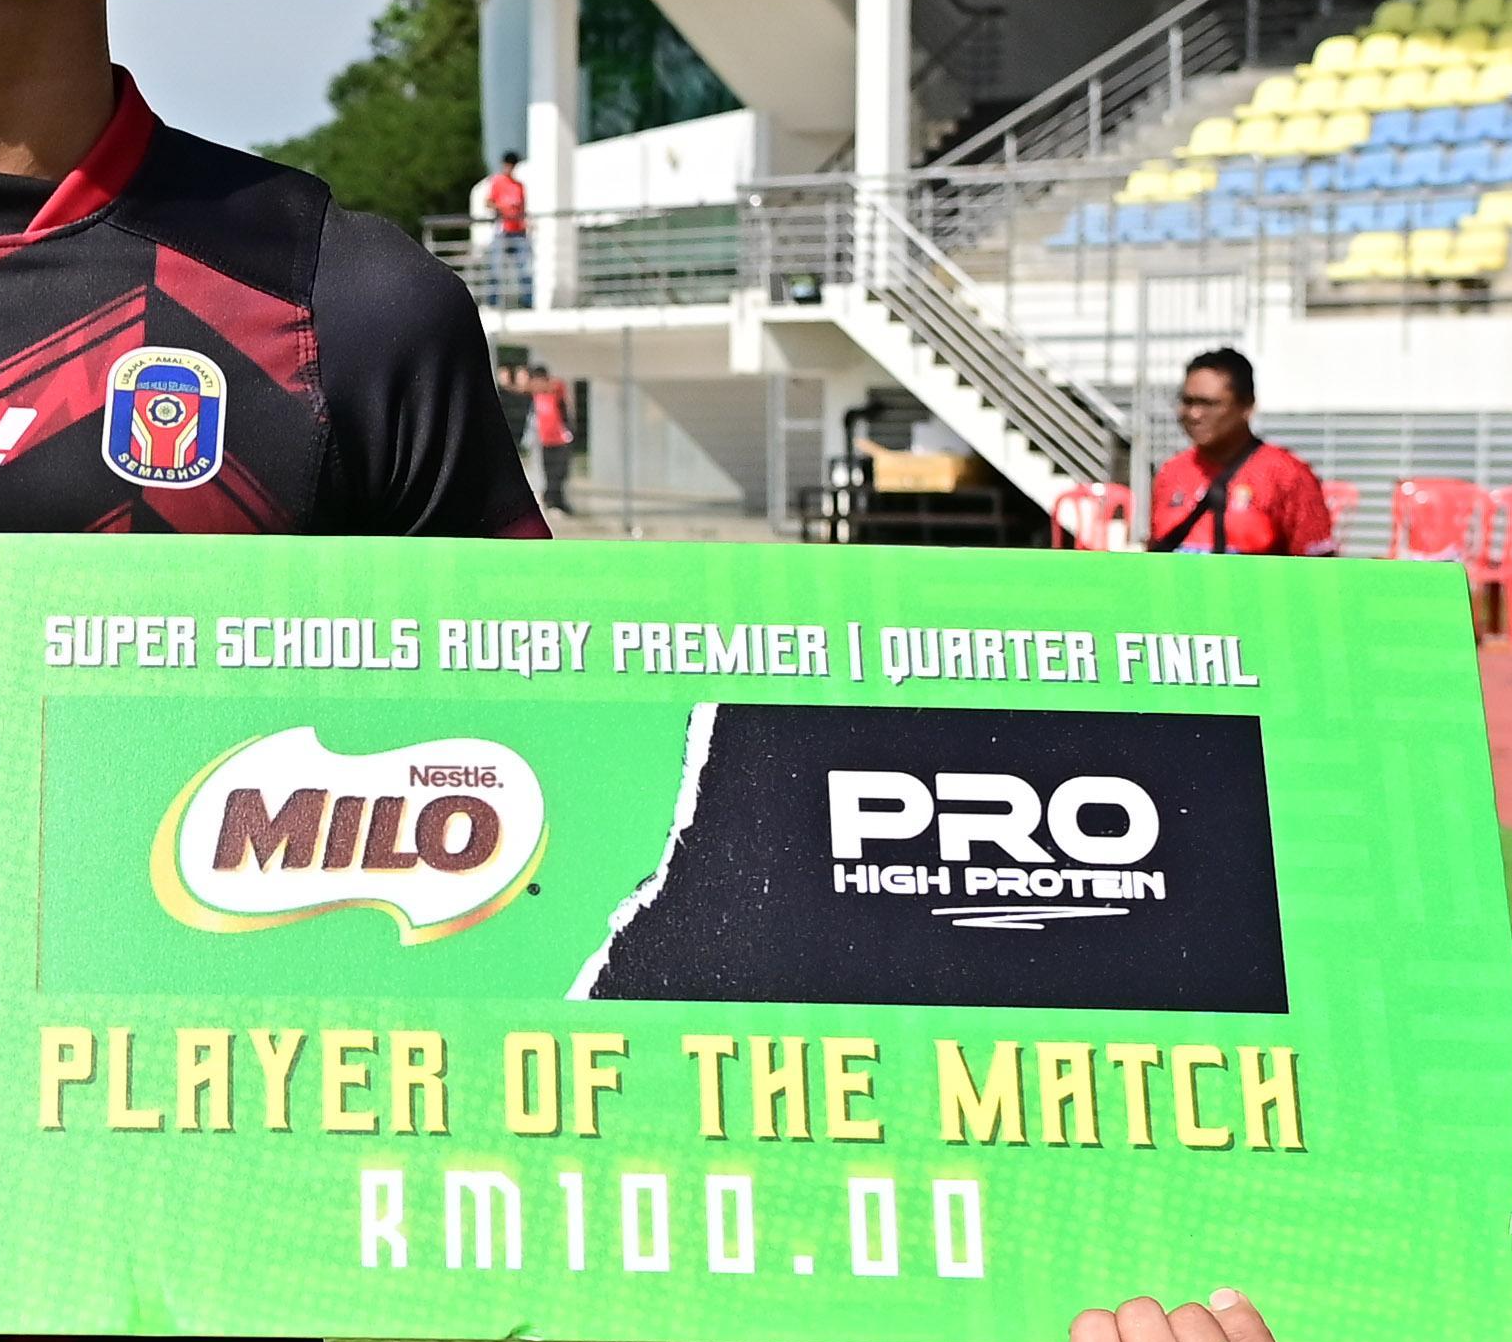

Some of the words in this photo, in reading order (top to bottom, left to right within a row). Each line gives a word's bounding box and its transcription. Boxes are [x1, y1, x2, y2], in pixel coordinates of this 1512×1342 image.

[155, 356, 184, 365] AMAL
[193, 364, 214, 388] BAKTI
[117, 452, 211, 480] SEMASHUR
[44, 615, 197, 669] SUPER
[216, 616, 420, 672] SCHOOLS
[438, 619, 592, 678] RUGBY
[612, 620, 829, 678] PREMIER
[880, 625, 1099, 687] QUARTER
[1116, 631, 1261, 688] FINAL
[211, 787, 504, 875] MILO
[827, 769, 1161, 865] PRO
[833, 863, 950, 896] HIGH
[965, 867, 1166, 901] PROTEIN
[38, 1024, 449, 1138] PLAYER
[502, 1031, 630, 1139] OF
[680, 1033, 885, 1144] THE
[933, 1037, 1308, 1153] MATCH
